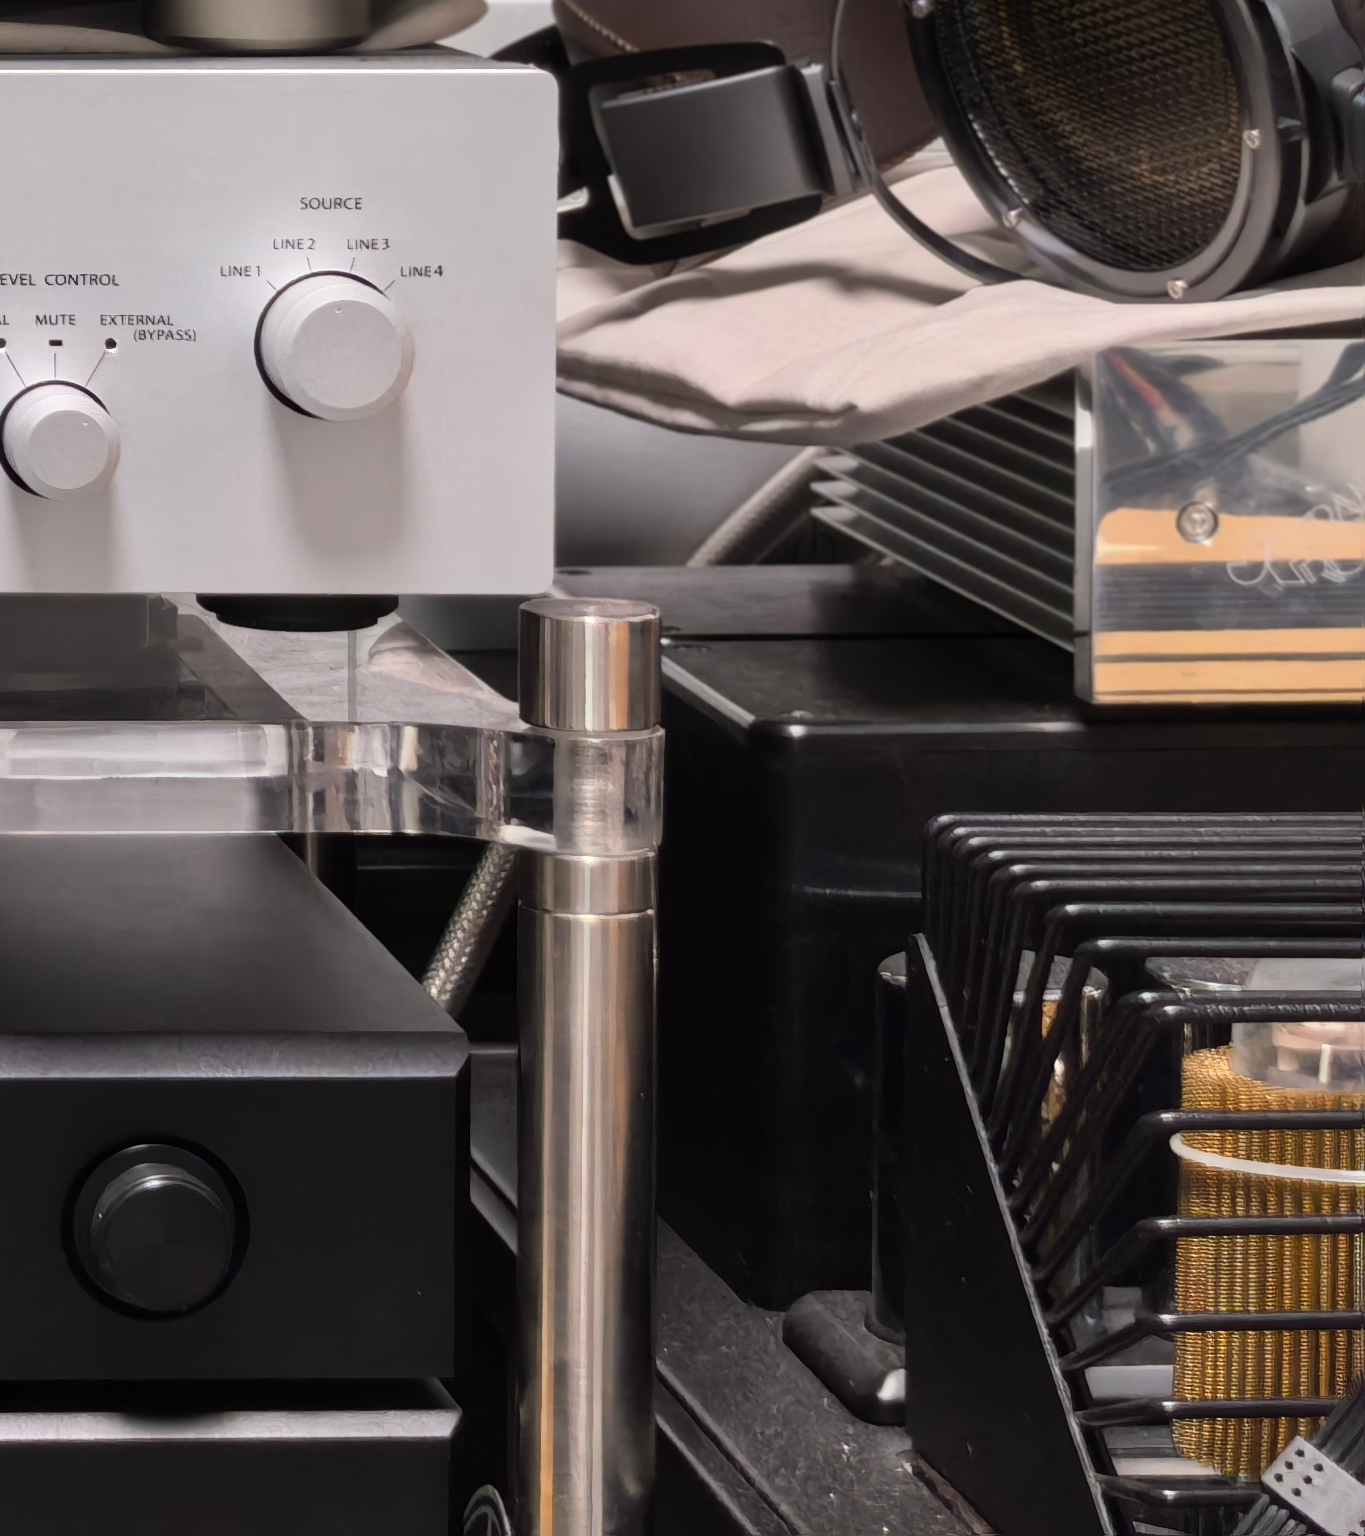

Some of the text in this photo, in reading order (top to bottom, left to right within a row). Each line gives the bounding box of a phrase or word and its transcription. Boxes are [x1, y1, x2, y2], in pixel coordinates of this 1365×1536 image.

[299, 197, 363, 211] SOURCE
[44, 273, 120, 287] CONTROL
[35, 313, 76, 327] MUTE
[99, 314, 174, 327] EXTERNAL
[133, 329, 197, 342] (BYPASS)
